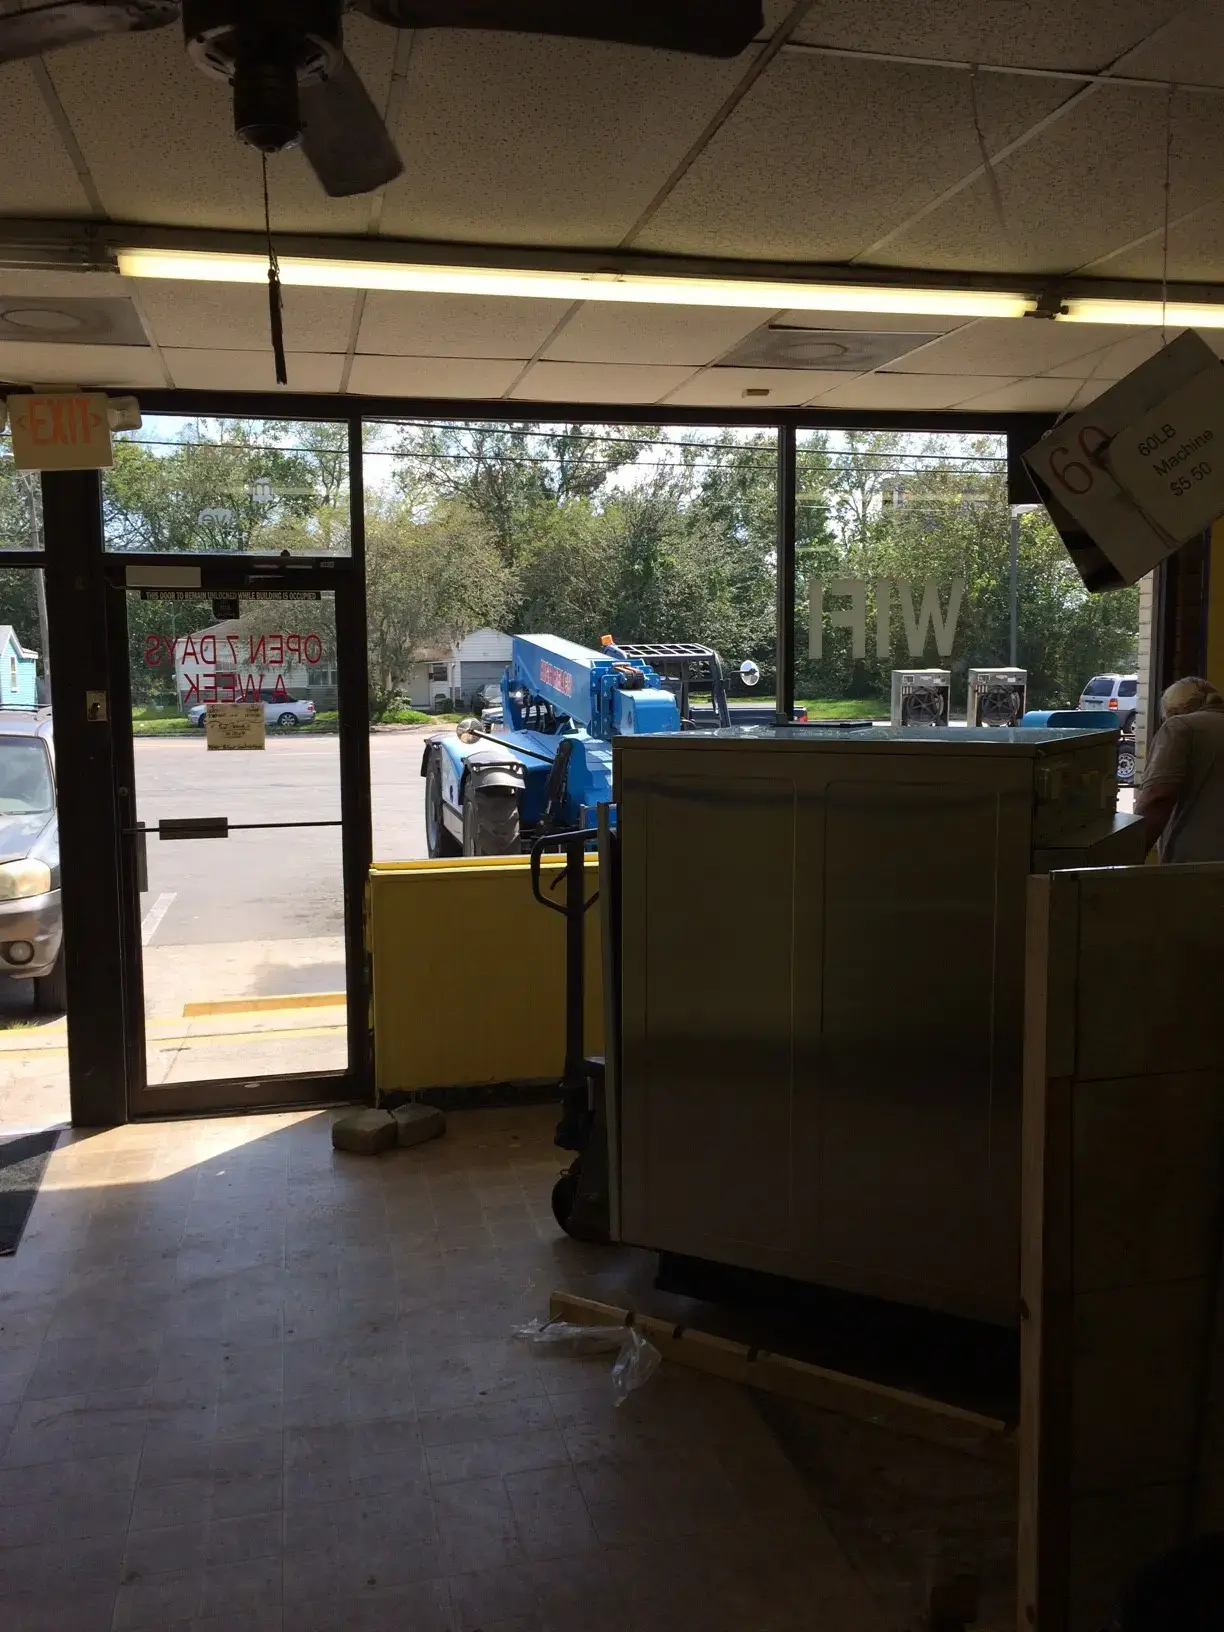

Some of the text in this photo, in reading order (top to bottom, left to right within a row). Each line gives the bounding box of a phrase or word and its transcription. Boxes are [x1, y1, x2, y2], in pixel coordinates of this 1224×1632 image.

[29, 398, 91, 444] EXIT
[1137, 423, 1177, 457] 60LB
[1152, 428, 1214, 477] Machine
[1170, 461, 1212, 497] $5.50
[145, 591, 317, 600] THIS DOOR TO REMAIN UNLOCKED WHILE BUILDING IS OCCUPIED
